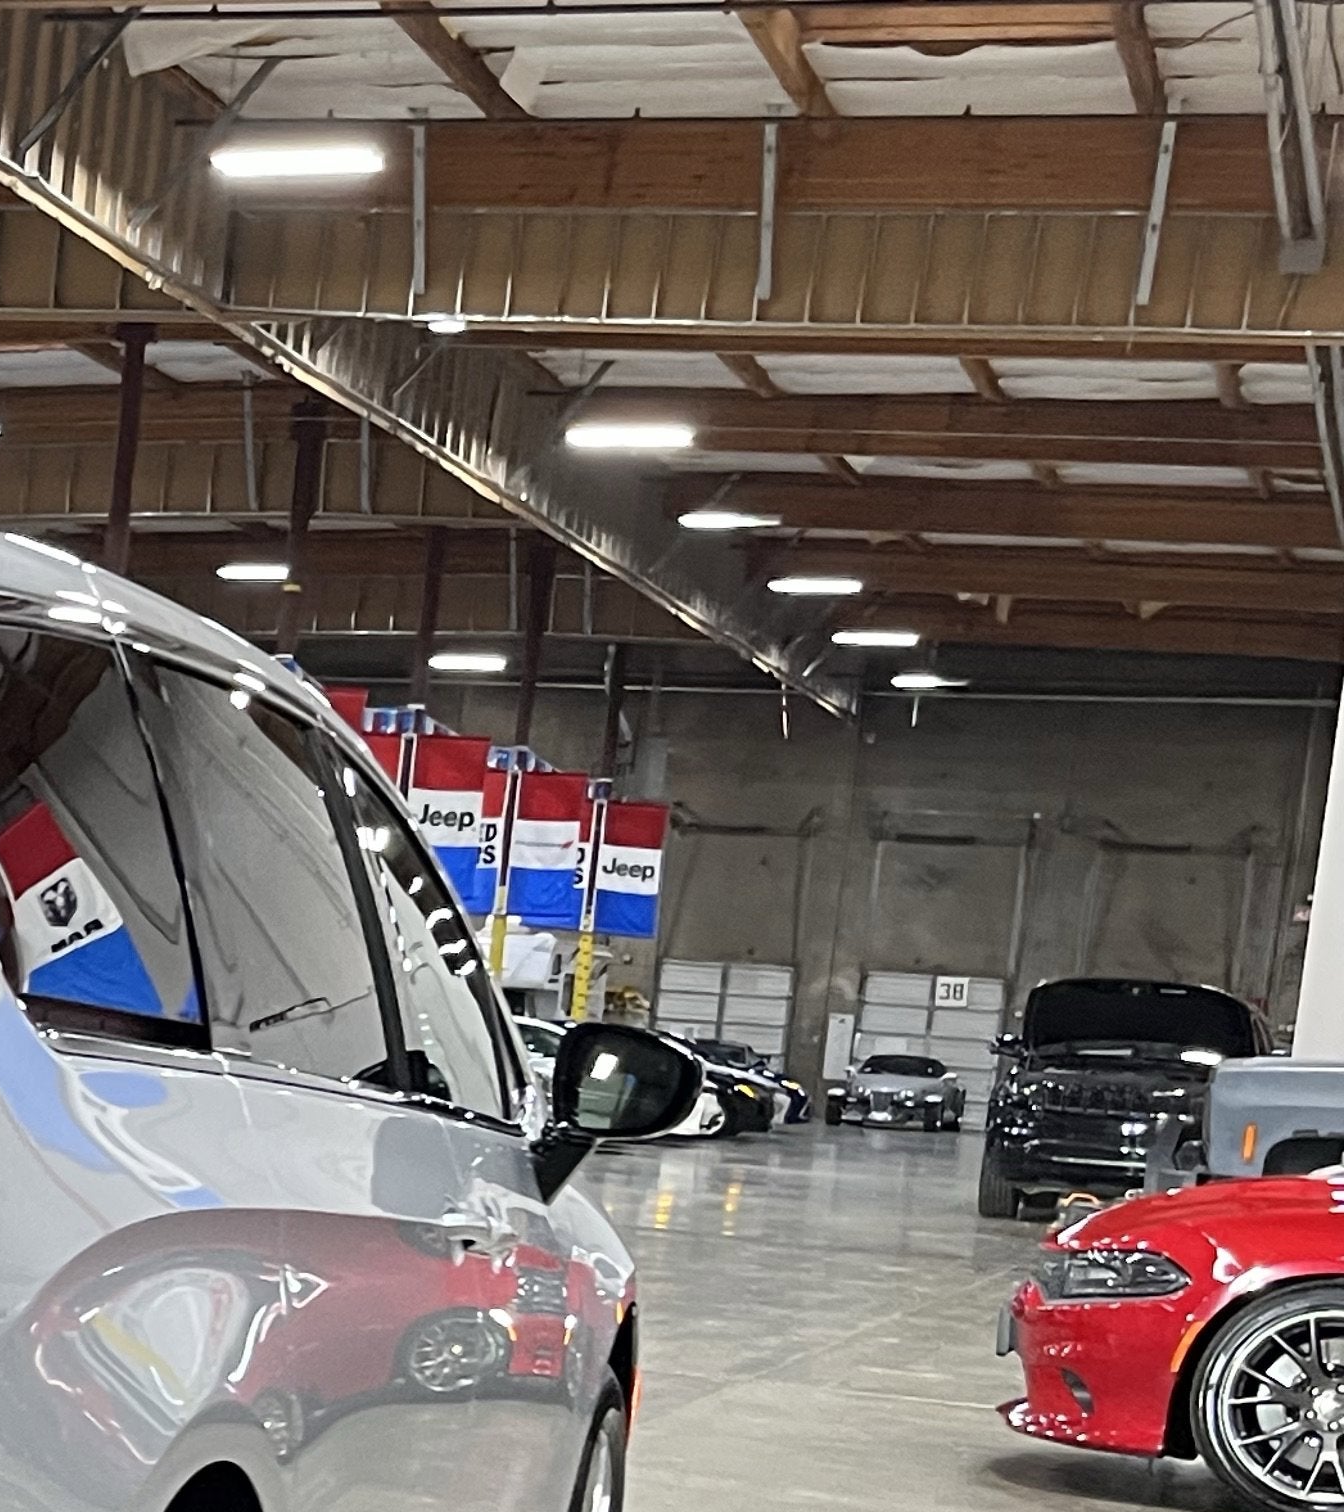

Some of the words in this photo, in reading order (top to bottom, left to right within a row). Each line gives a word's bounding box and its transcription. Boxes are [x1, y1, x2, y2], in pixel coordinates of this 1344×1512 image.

[418, 803, 475, 831] Jeep
[602, 857, 655, 882] Jeep
[938, 983, 965, 1001] 38
